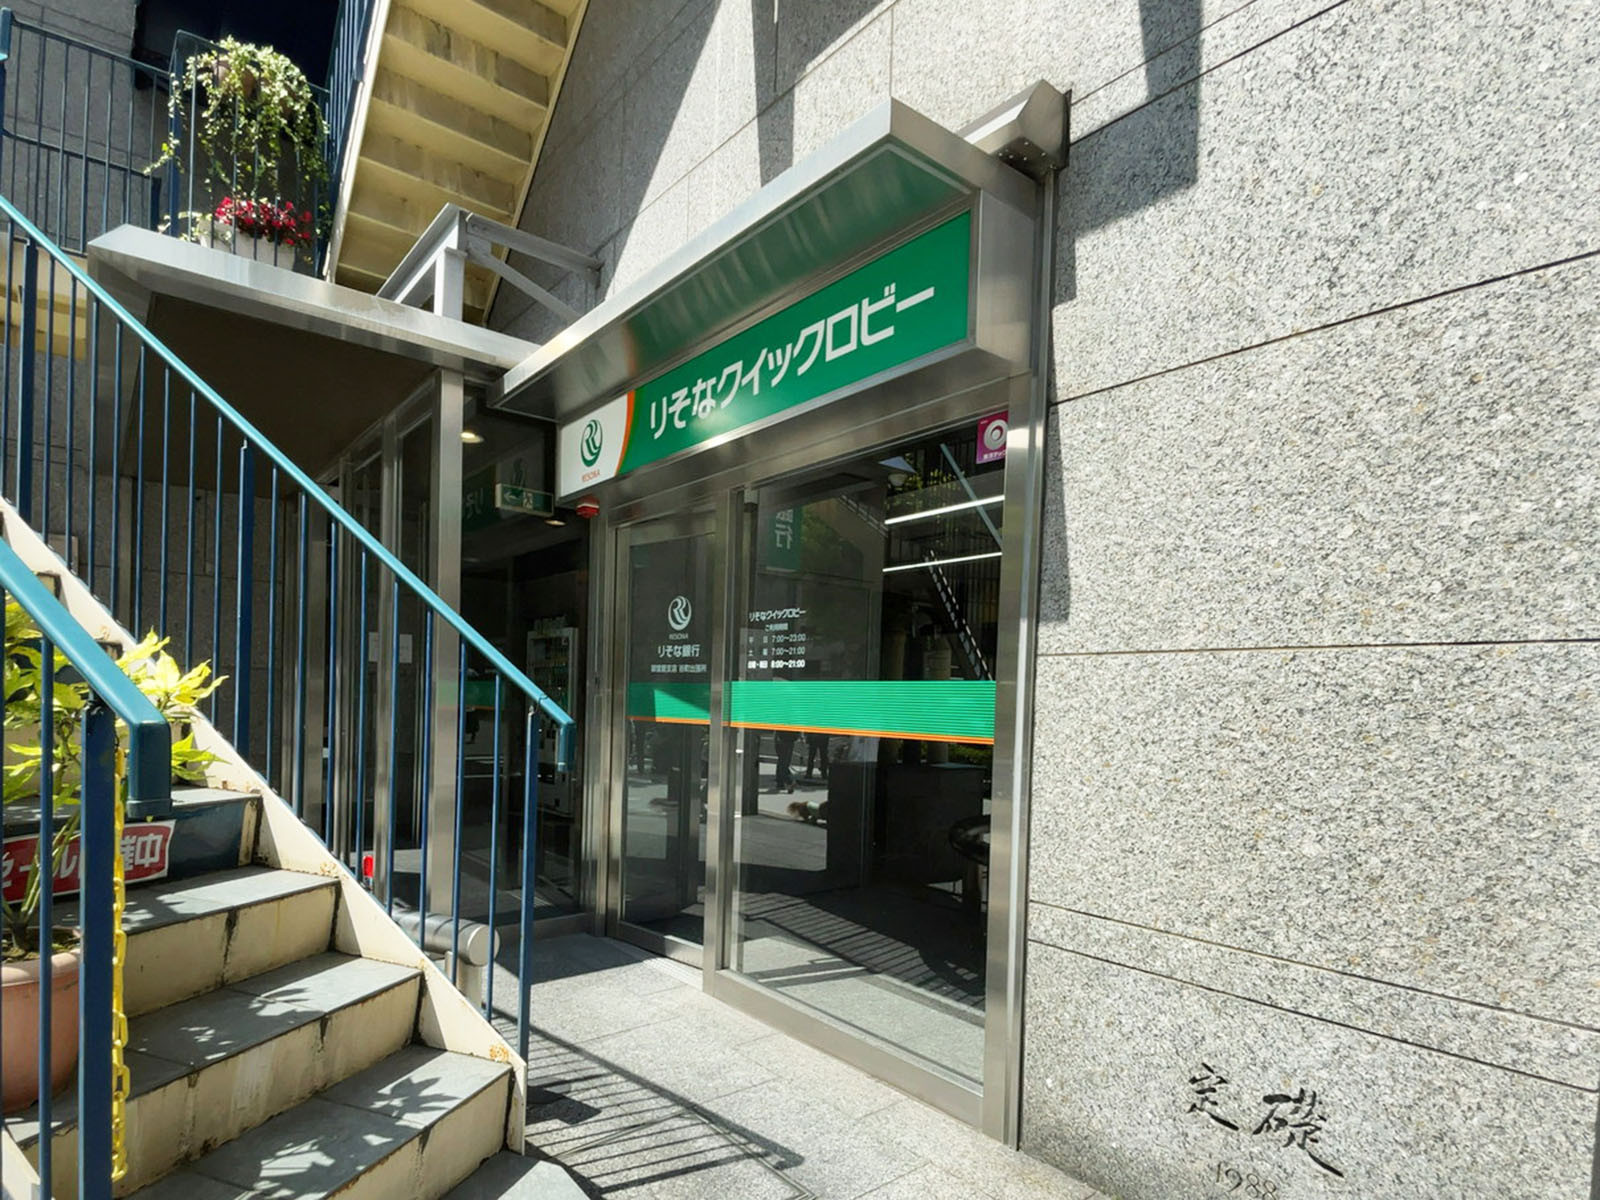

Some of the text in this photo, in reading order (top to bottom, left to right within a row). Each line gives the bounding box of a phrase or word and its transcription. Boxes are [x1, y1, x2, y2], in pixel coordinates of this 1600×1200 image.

[650, 282, 935, 440] りそなクイックロビー
[657, 644, 701, 658] りそな銀行
[1216, 1161, 1277, 1200] 1988
